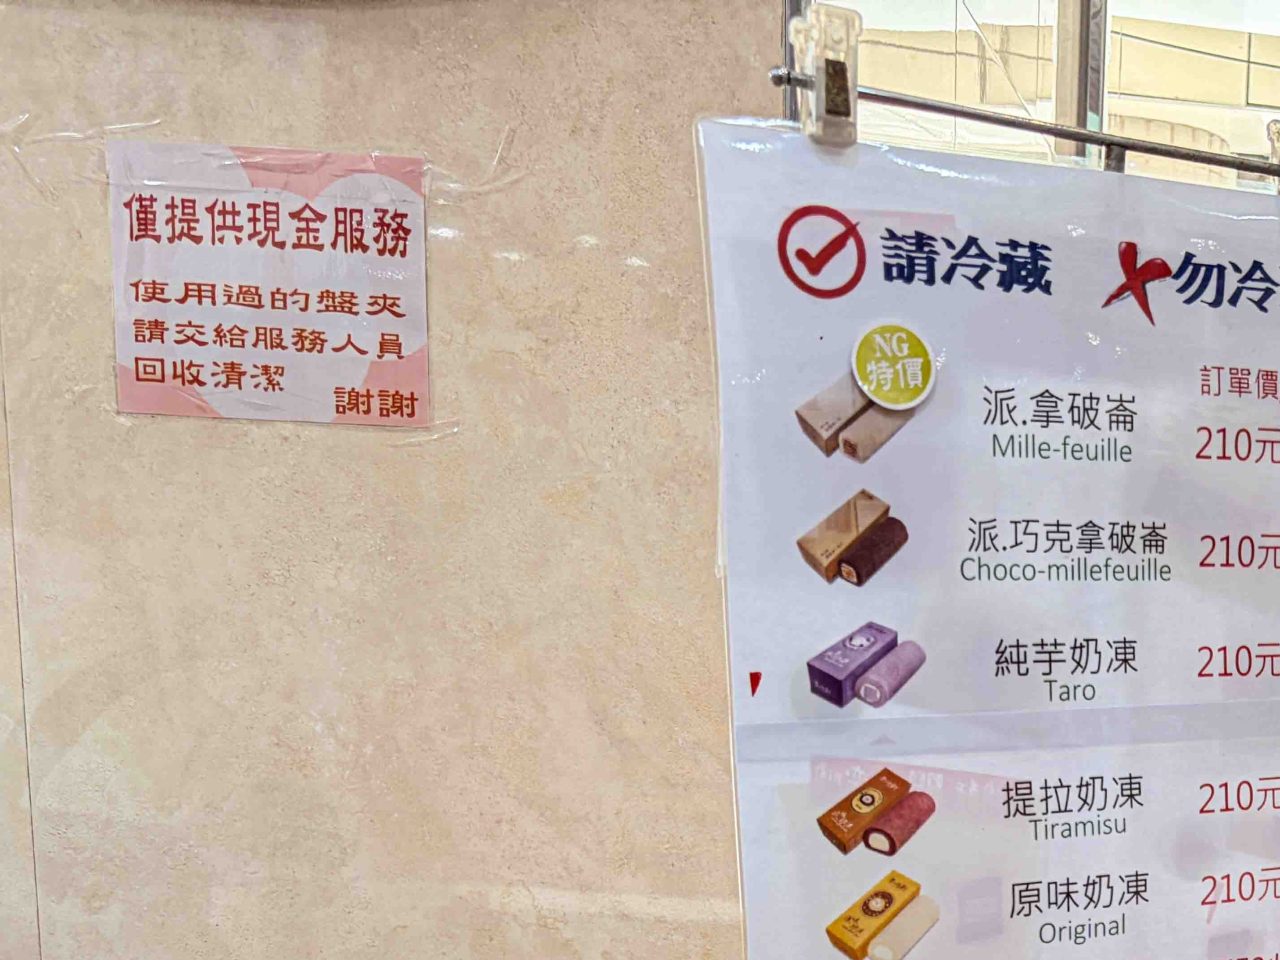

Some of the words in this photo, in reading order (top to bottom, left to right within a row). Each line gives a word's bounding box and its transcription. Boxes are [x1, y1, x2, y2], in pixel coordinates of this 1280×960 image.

[123, 193, 411, 258] 僅提供現金服務
[881, 227, 1053, 295] 請冷藏
[130, 279, 407, 318] 使用過的盤夾
[133, 319, 404, 360] 請交給服務人員
[874, 332, 909, 357] NG
[134, 357, 286, 392] 回收清潔
[866, 358, 924, 391] 特價
[334, 386, 418, 418] 謝謝
[991, 434, 1133, 463] Mille-feuille
[959, 557, 1172, 584] Choco-millefeuille
[994, 637, 1139, 677] 純芋奶凍
[1043, 680, 1097, 702] Taro
[1001, 772, 1145, 819] 提拉奶凍
[1028, 815, 1127, 842] Tiramisu
[1009, 871, 1150, 918] 原味奶凍
[1038, 915, 1126, 947] Original
